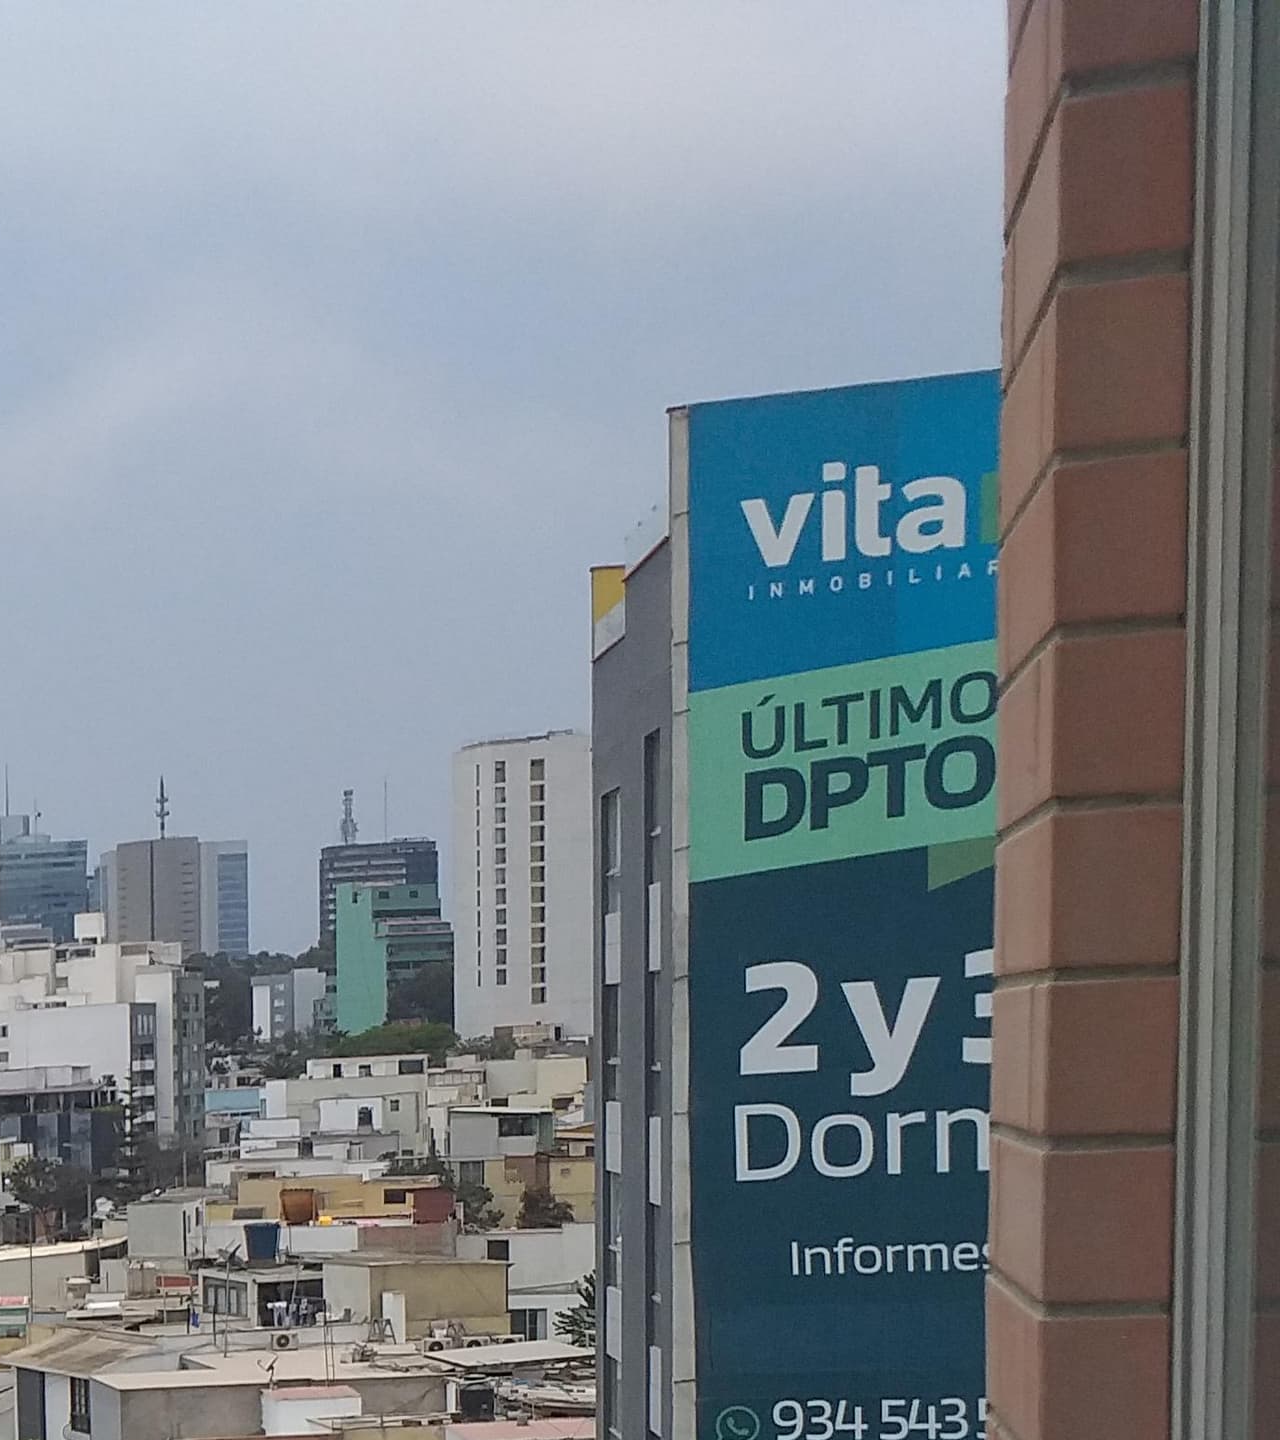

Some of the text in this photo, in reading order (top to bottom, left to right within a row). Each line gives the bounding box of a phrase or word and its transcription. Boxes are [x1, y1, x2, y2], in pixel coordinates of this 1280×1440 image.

[741, 461, 968, 568] vita
[741, 671, 998, 760] ÚLTIMO
[744, 735, 997, 842] DPTO
[739, 961, 819, 1075] 2
[840, 976, 942, 1097] y
[879, 1397, 989, 1440] 543
